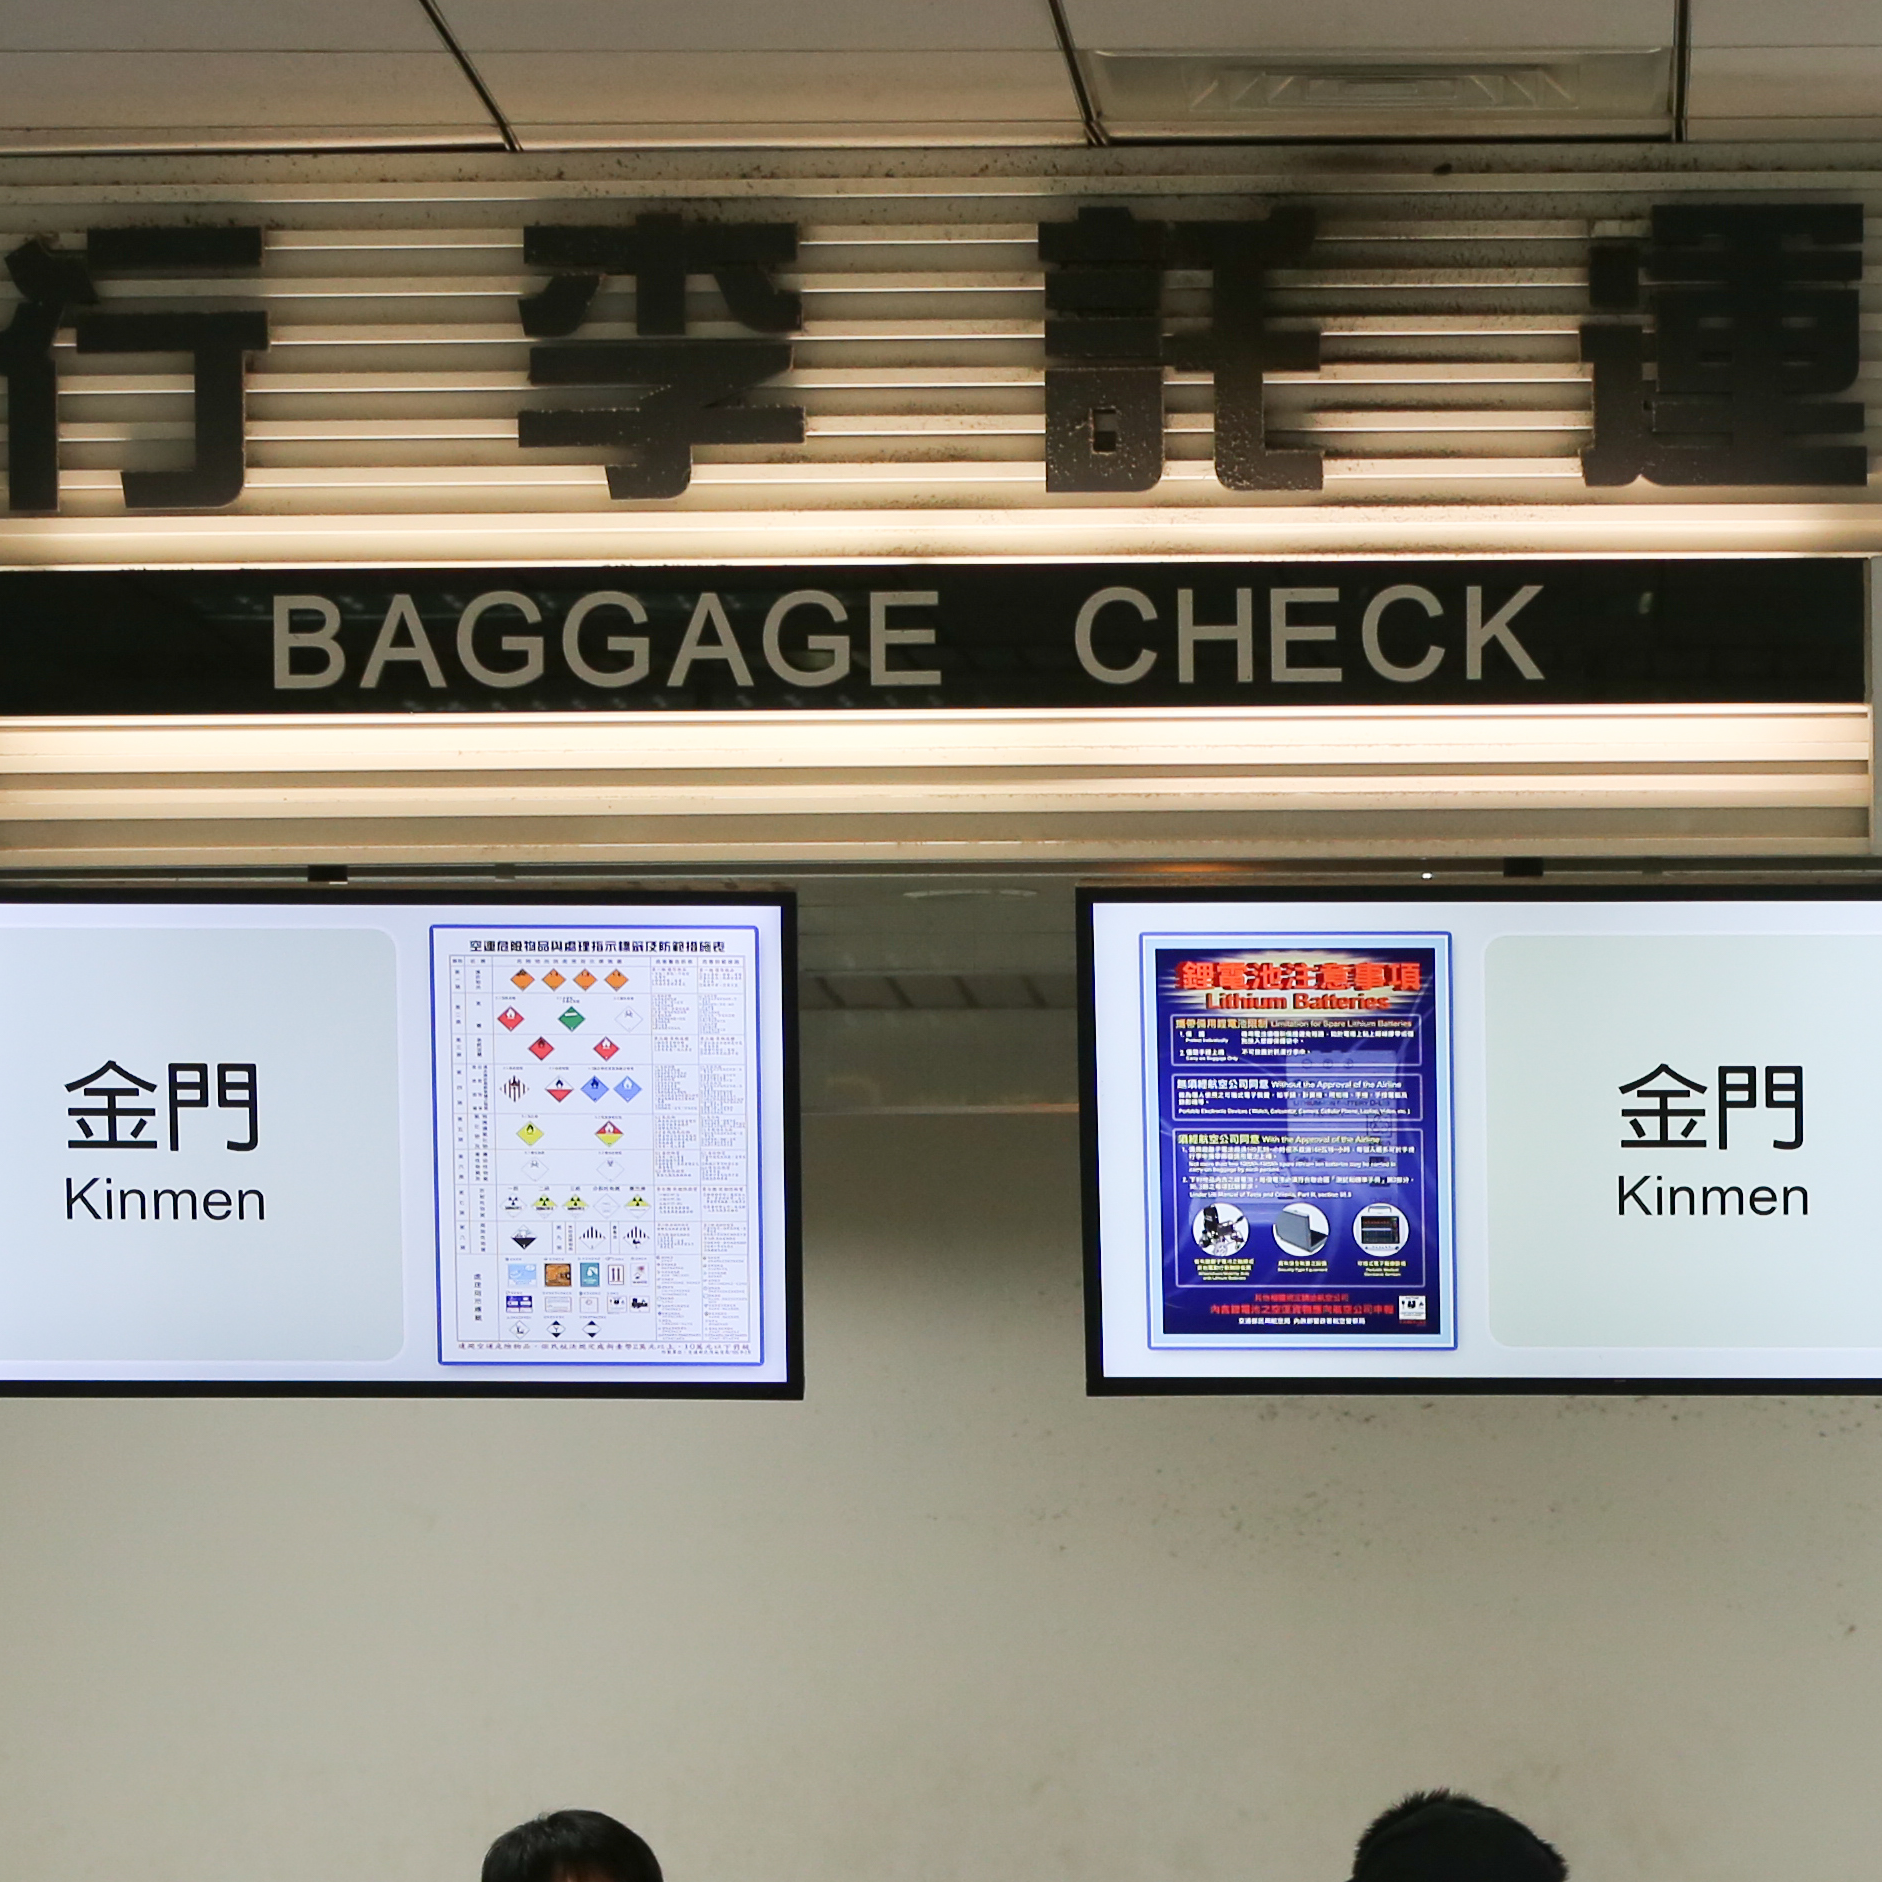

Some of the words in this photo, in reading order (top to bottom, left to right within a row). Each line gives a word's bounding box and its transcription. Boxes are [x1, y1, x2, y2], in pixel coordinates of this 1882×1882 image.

[270, 588, 944, 692] BAGGAGE
[1072, 582, 1546, 686] CHECK
[1177, 961, 1422, 991] 鋰電池注意事項
[1205, 992, 1288, 1010] Lithium
[1292, 992, 1391, 1010] Batteries
[63, 1059, 260, 1153] 金門
[1617, 1061, 1805, 1151] 金門
[65, 1176, 266, 1221] Kinmen
[1617, 1174, 1809, 1217] Kinmen
